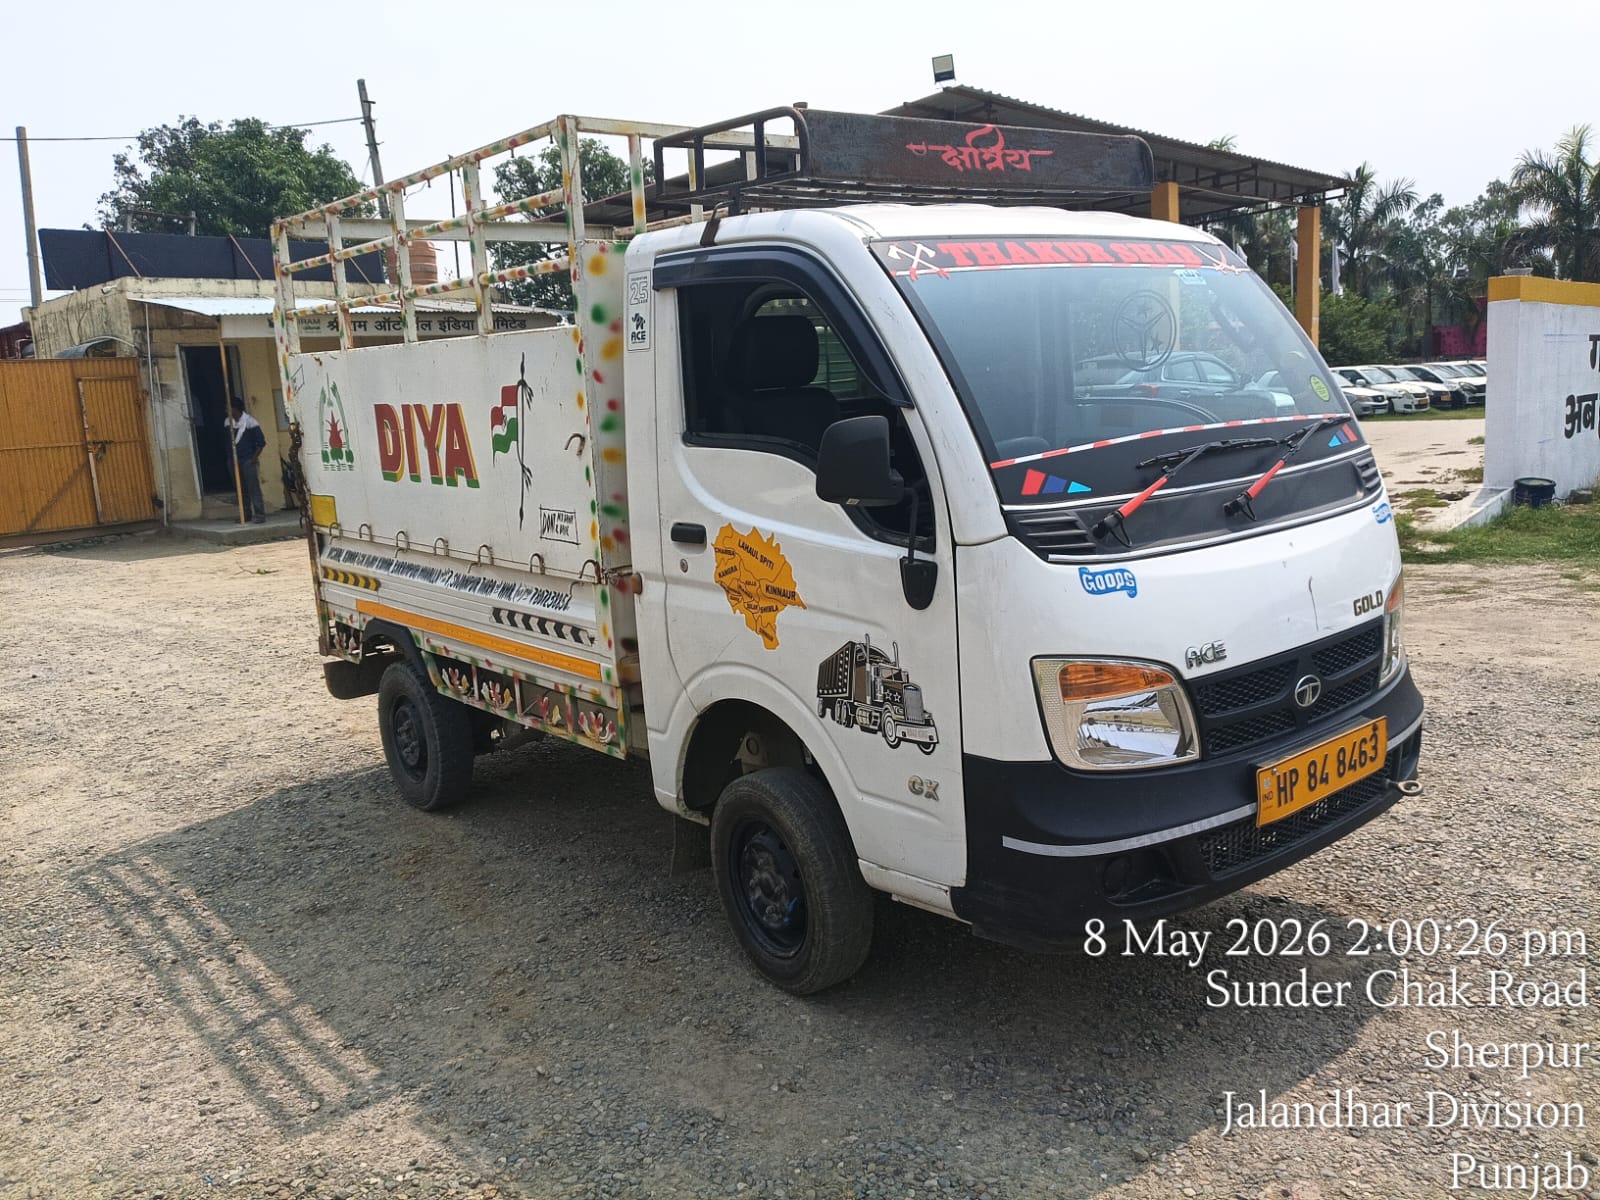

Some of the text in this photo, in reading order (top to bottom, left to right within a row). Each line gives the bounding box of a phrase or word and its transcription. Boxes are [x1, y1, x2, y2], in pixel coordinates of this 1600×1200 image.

[937, 241, 1110, 267] THAKUR
[630, 282, 649, 305] 25
[438, 315, 475, 332] इंडिया
[631, 330, 647, 342] ACE
[374, 403, 480, 489] DIYA
[738, 539, 775, 571] LAHAUL SPITI
[765, 584, 796, 602] KINNAUR
[1353, 589, 1384, 617] GOLD
[1184, 639, 1227, 670] ACE
[1276, 731, 1379, 808] HP 84 8463
[908, 775, 940, 802] CX
